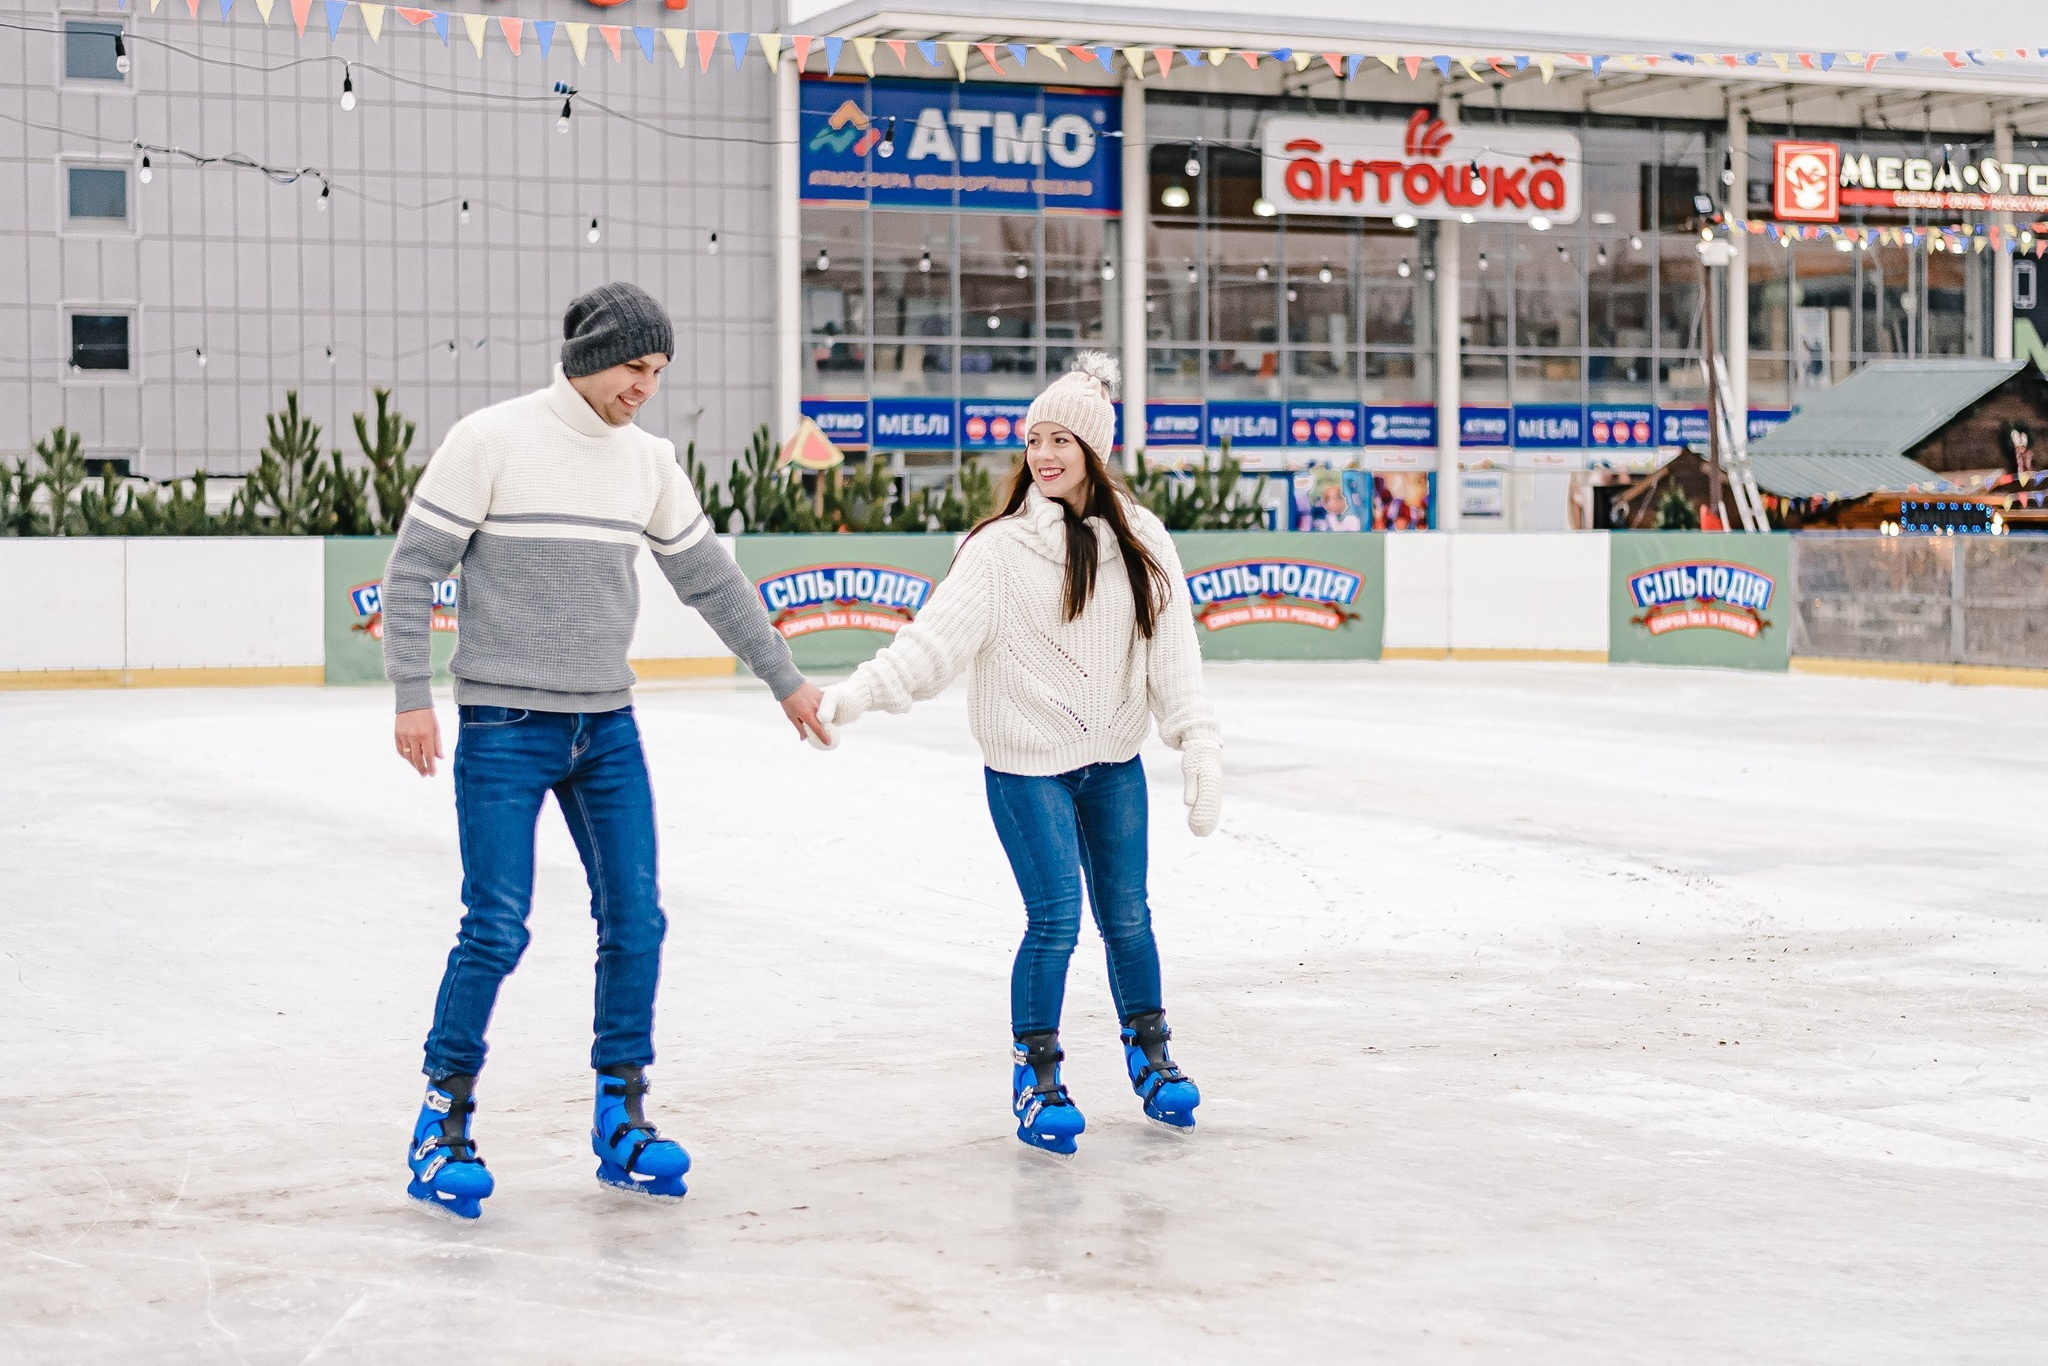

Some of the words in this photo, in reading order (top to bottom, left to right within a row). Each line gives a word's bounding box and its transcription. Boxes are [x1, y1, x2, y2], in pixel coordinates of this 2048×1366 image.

[906, 107, 1097, 168] АТМО
[877, 413, 950, 436] МЕБЛІ
[1370, 413, 1388, 440] 2
[767, 568, 925, 609] СІЛЬПОДІЯ
[1192, 564, 1353, 603] СІЛЬПОДІЯ
[1638, 566, 1769, 608] СІЛЬПОДІЯ
